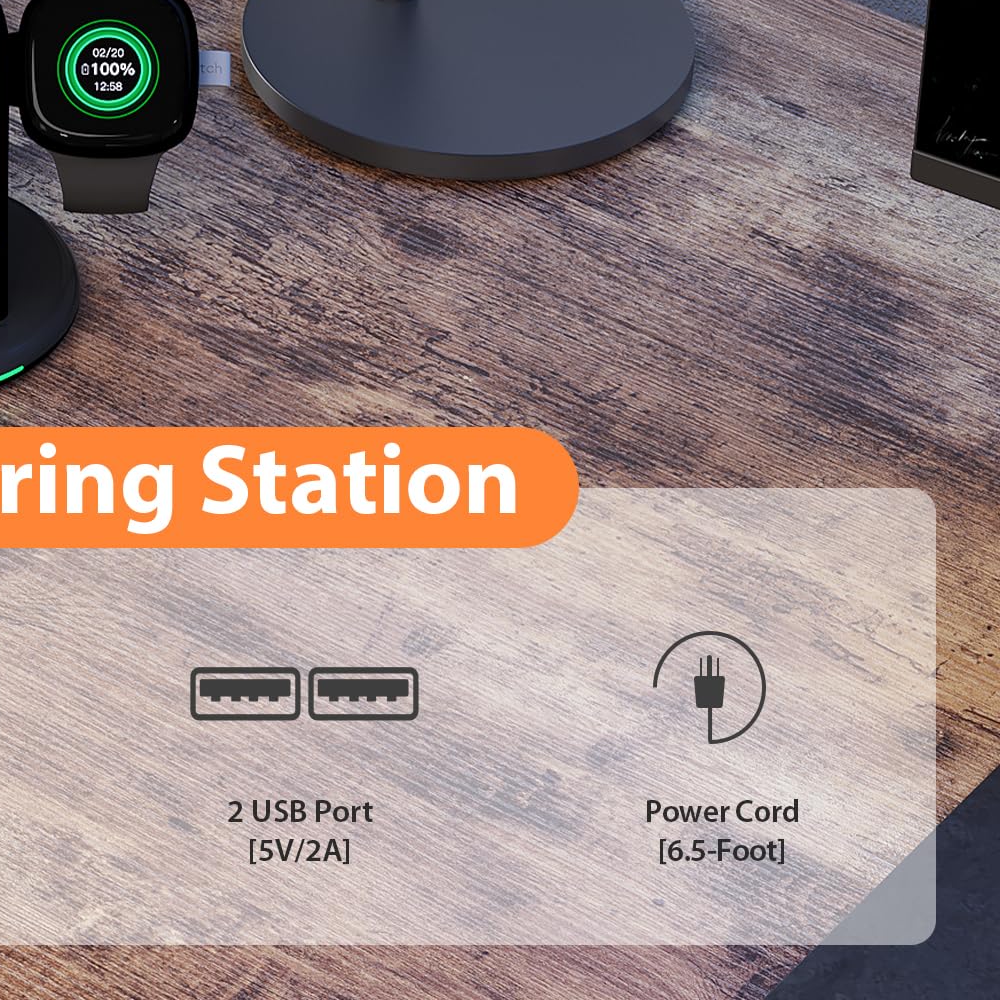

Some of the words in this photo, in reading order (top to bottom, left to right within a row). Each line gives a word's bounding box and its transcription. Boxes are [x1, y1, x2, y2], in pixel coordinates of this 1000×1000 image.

[92, 47, 125, 58] 02/20
[91, 62, 136, 76] 100%
[94, 81, 123, 92] 12:58
